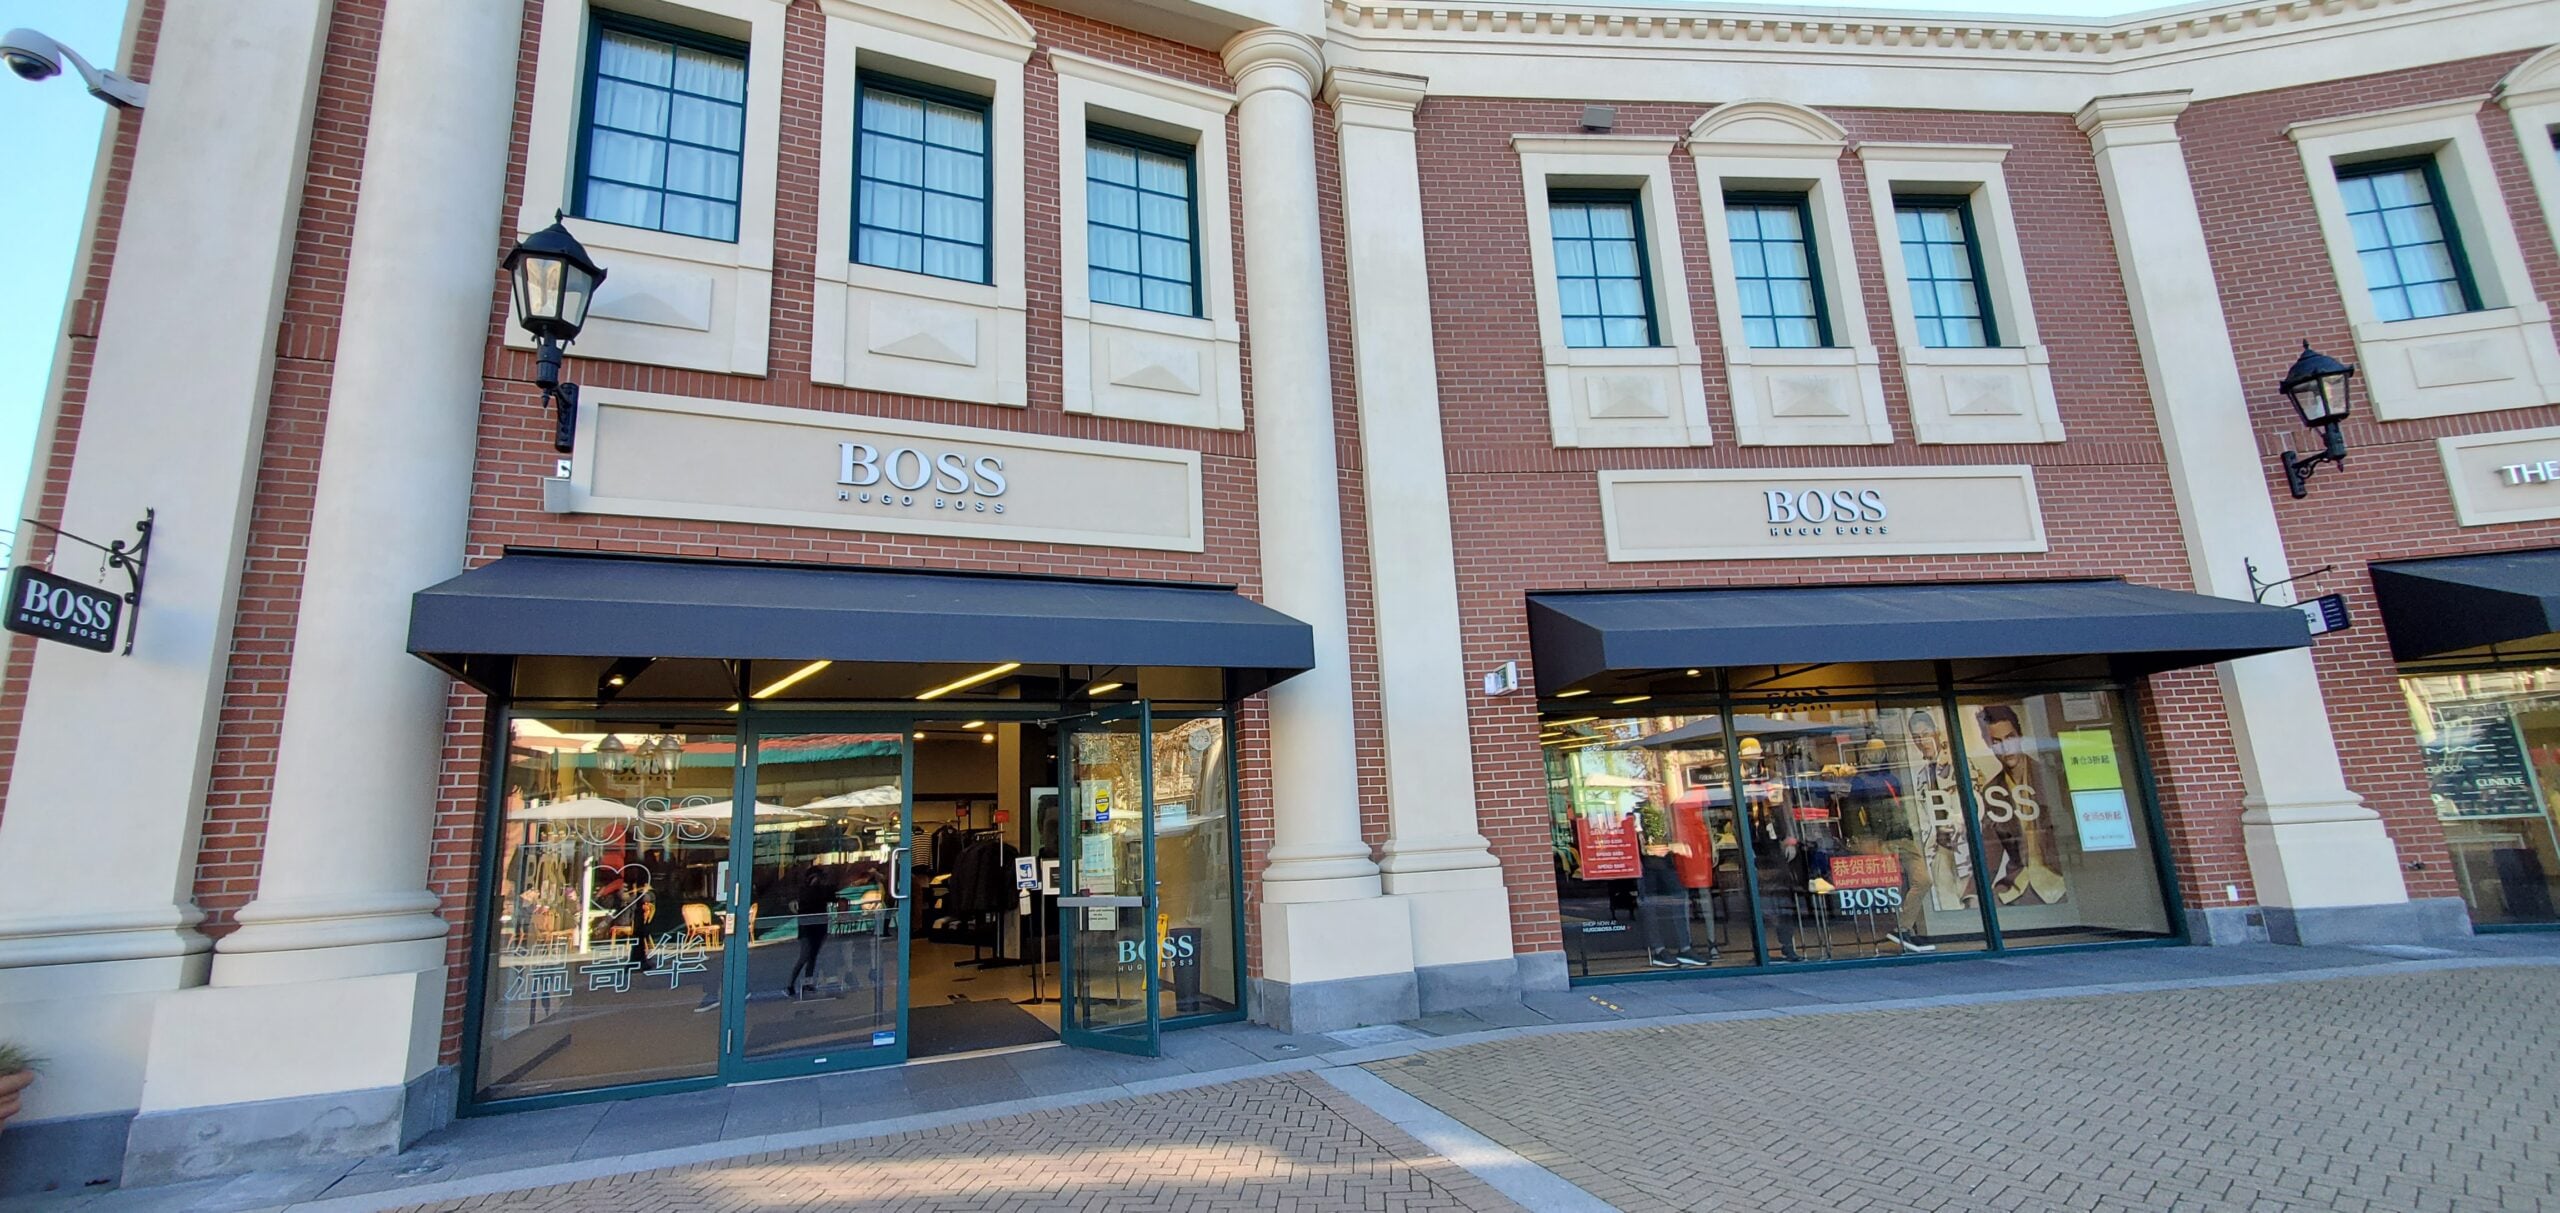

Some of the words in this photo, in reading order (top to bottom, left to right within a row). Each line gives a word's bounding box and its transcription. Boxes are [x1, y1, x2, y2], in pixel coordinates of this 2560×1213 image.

[837, 442, 1007, 497] BOSS
[2501, 460, 2560, 484] THE
[838, 490, 913, 506] HUGO
[934, 497, 1005, 514] BOSS
[1763, 488, 1888, 524] BOSS
[1770, 526, 1823, 537] HUGO
[1836, 525, 1889, 535] BOSS
[21, 578, 112, 630] BOSS
[19, 613, 62, 630] HUGO
[69, 625, 108, 642] BOSS
[2475, 776, 2526, 787] CLINIQUE
[1834, 855, 1897, 876] 恭贺新禧
[1839, 887, 1902, 908] BOSS
[1161, 959, 1193, 968] BOSS
